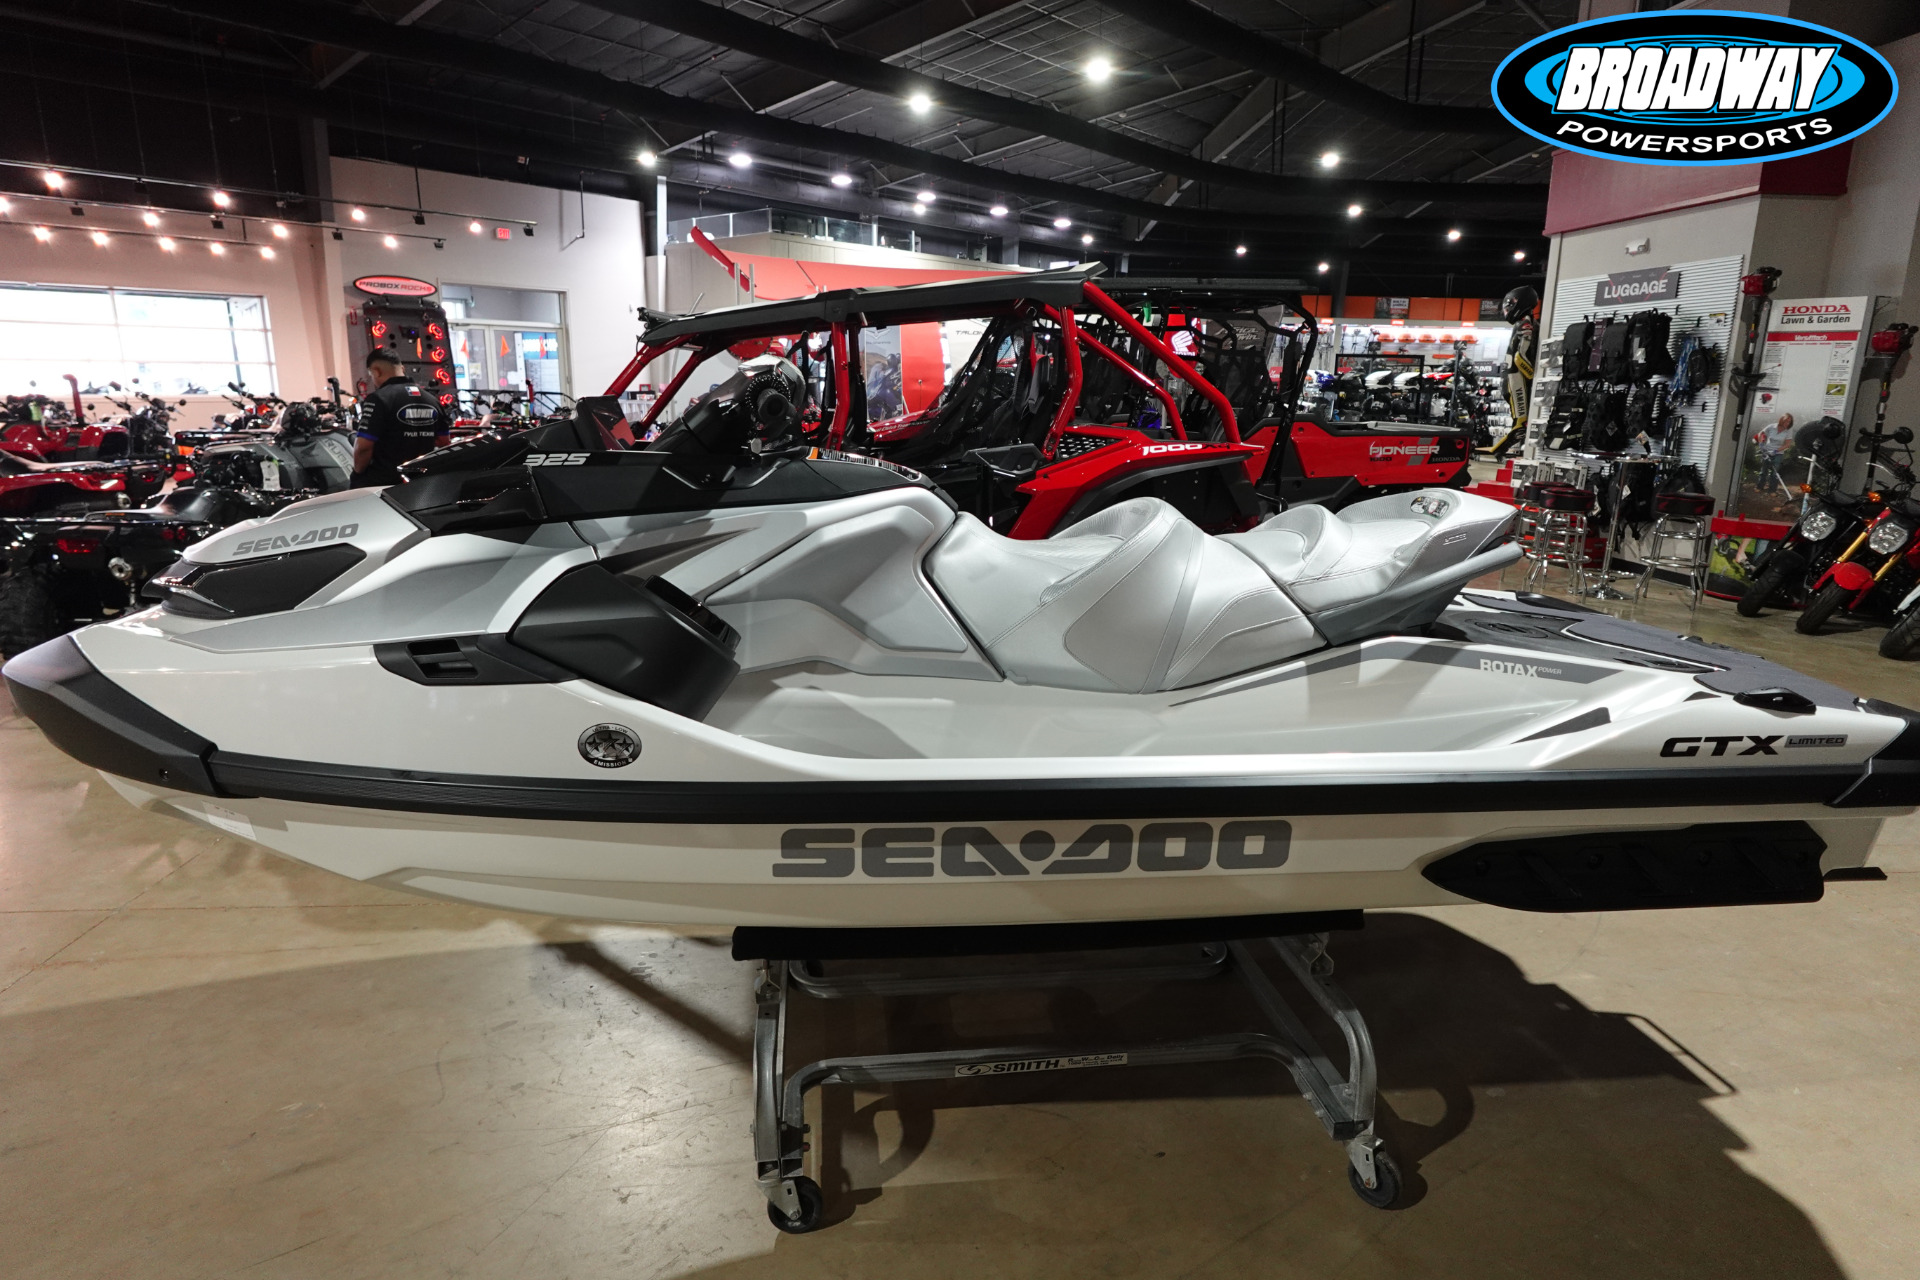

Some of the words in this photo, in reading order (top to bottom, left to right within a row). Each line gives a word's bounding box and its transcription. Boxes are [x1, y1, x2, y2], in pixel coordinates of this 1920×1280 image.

[1603, 279, 1669, 299] LUGGAGE
[1781, 304, 1851, 315] HONDA
[1780, 316, 1804, 325] Lawn
[1807, 316, 1814, 324] &
[1816, 315, 1850, 324] Garden
[1516, 386, 1526, 417] YAMAHA
[1142, 443, 1203, 456] 1000
[1369, 445, 1441, 456] PIONEER
[523, 453, 592, 467] 325
[1479, 658, 1539, 678] ROTAX
[1538, 666, 1563, 676] POWER
[1659, 735, 1786, 758] GTX
[1787, 736, 1846, 747] LIMITED
[993, 1059, 1060, 1073] SMITH
